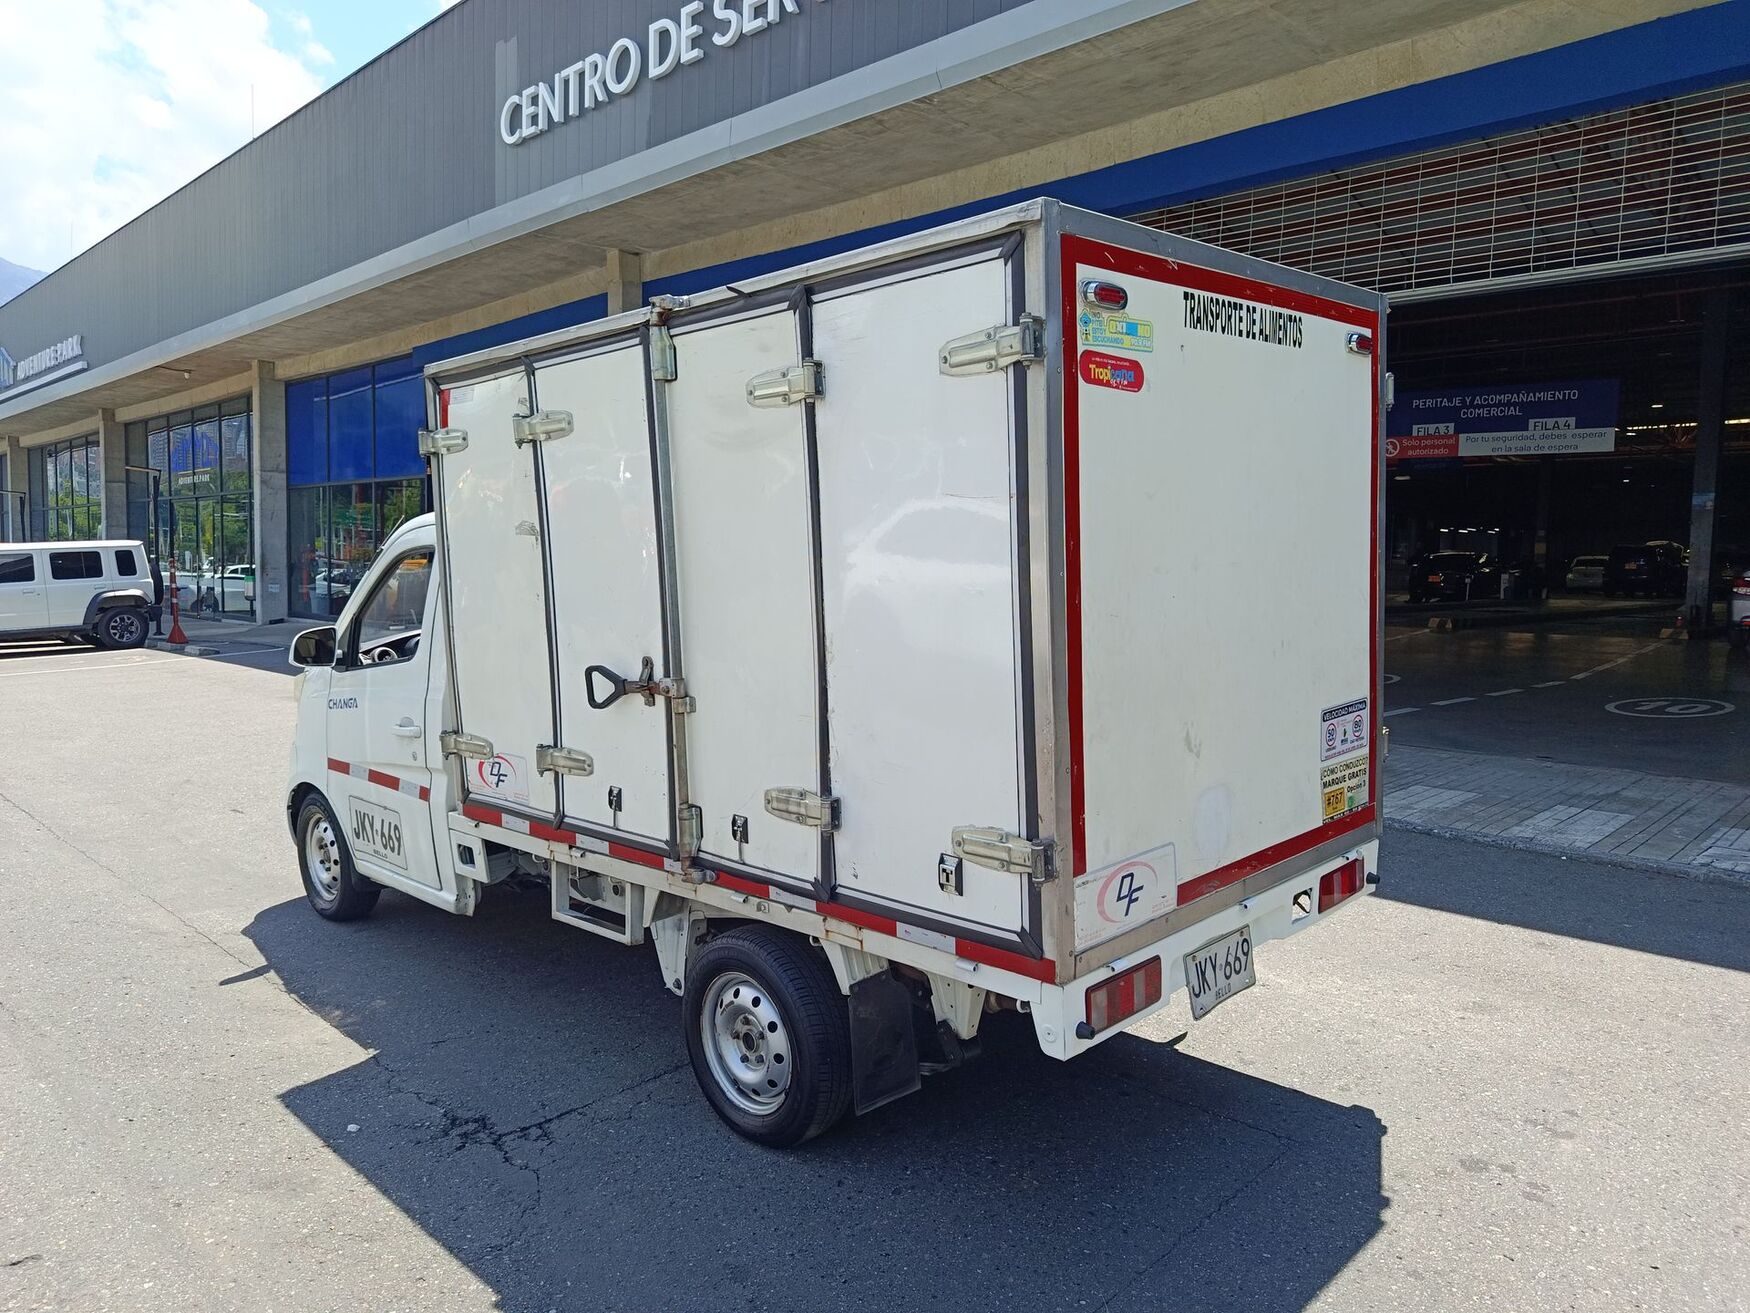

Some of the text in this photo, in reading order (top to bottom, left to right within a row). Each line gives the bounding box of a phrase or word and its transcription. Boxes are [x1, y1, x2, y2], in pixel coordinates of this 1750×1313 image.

[500, 38, 641, 145] CENTRO
[649, 0, 704, 80] DE
[1183, 290, 1243, 338] TRANSPORTE
[1245, 304, 1257, 340] DE
[1258, 307, 1303, 349] ALIMENTOS
[1413, 390, 1579, 409] PERITAJE Y ACOMPAÑAMIENTO
[1460, 406, 1523, 418] COMERCIAL
[1417, 425, 1451, 436] FILA 3
[1533, 419, 1571, 431] FILA 4
[1402, 436, 1456, 448] Solo personal
[1466, 435, 1479, 443] Por
[1481, 434, 1490, 443] tu
[1539, 431, 1568, 441] debes
[1571, 430, 1608, 442] esperar
[1407, 446, 1449, 456] autorizado
[1491, 442, 1579, 453] en la sala de espera
[328, 697, 358, 710] CHANGA
[1322, 767, 1368, 789] MARQUE GRATIS
